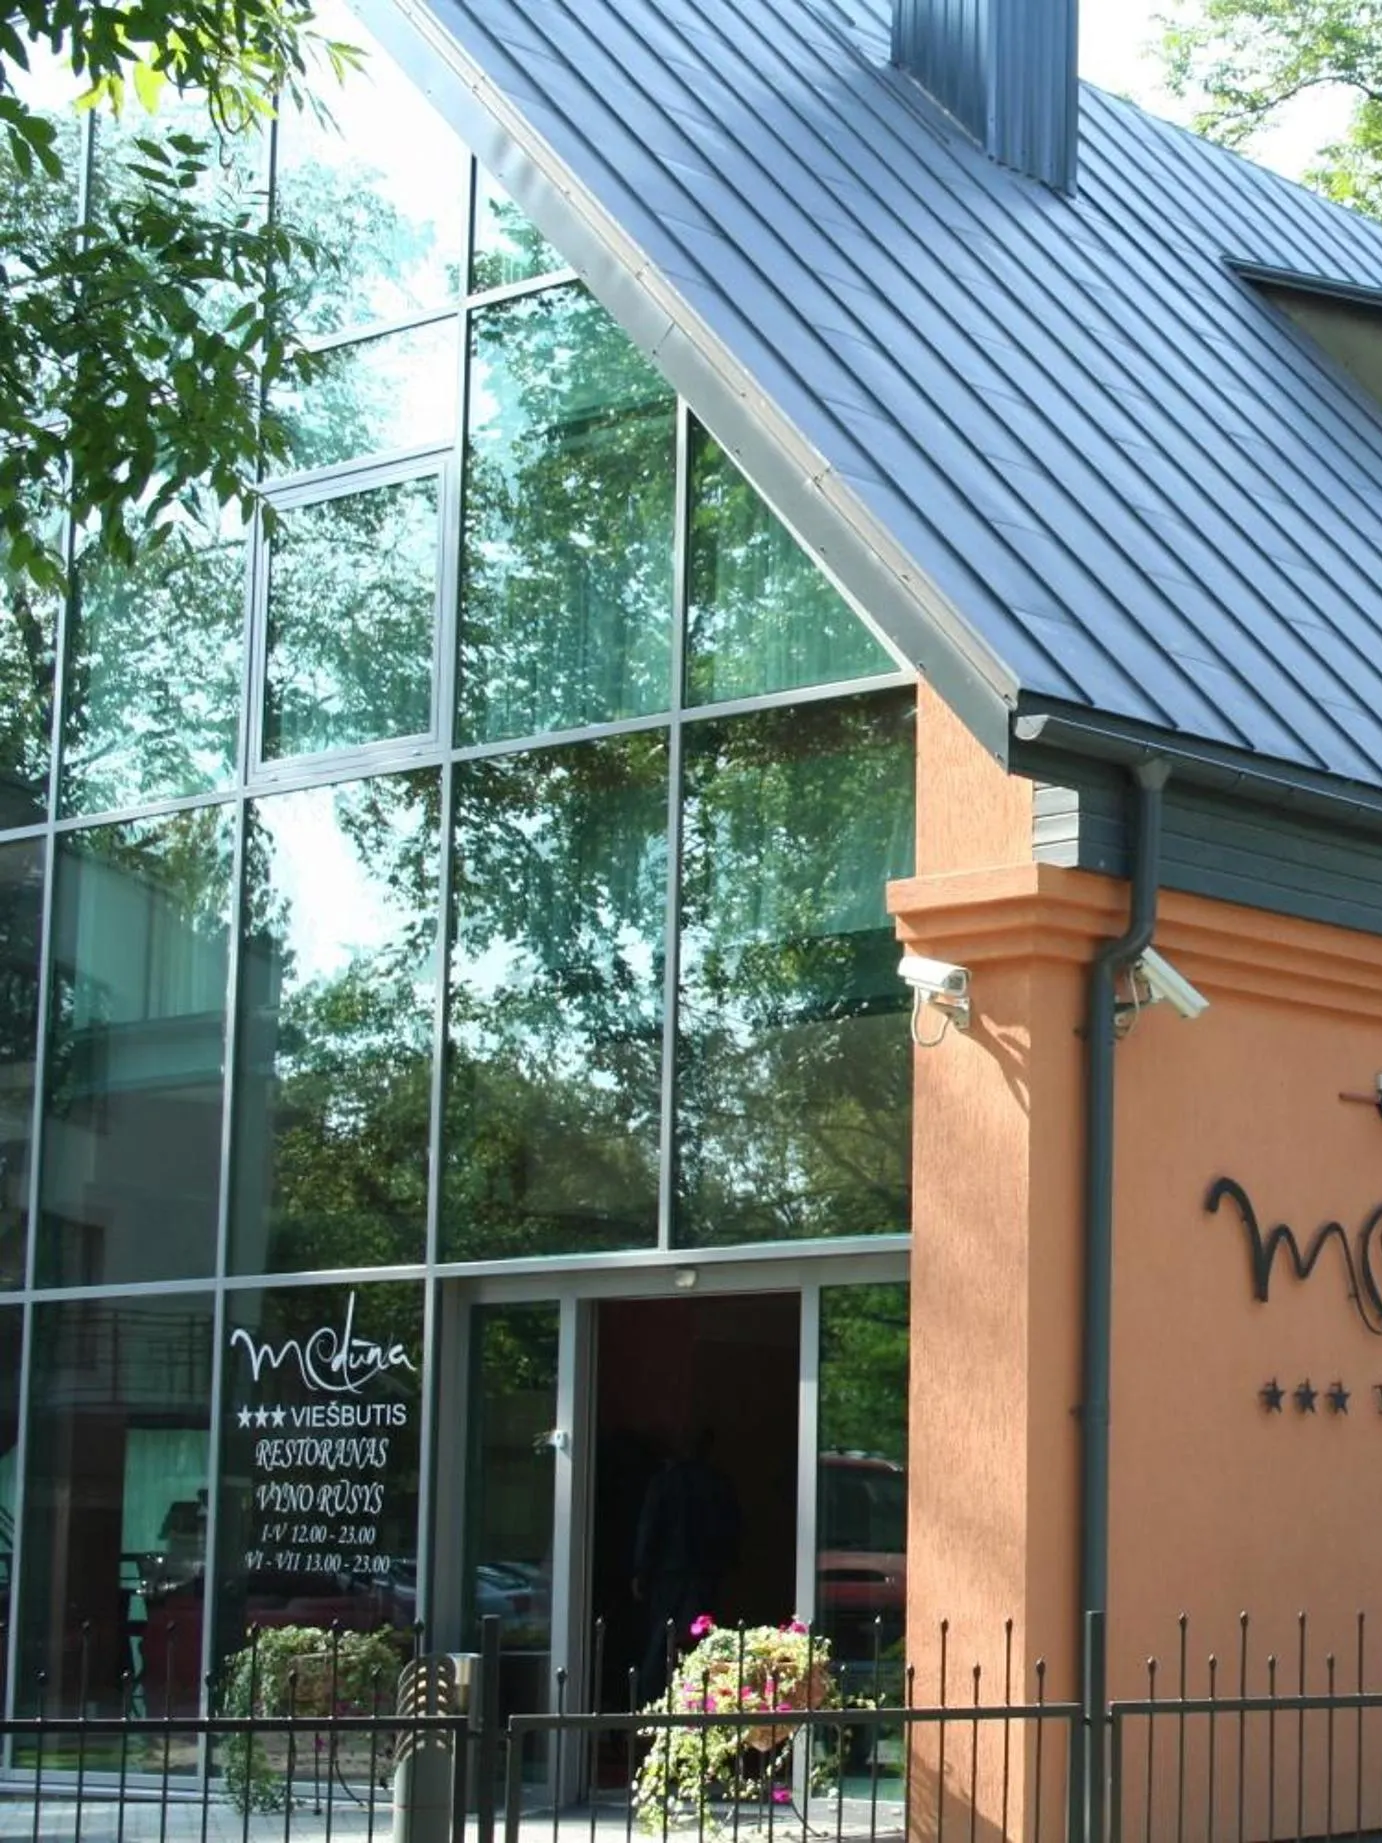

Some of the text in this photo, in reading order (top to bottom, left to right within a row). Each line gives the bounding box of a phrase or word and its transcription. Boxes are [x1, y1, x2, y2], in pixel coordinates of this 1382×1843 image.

[290, 1400, 408, 1428] VIEŠBUTIS
[255, 1436, 390, 1472] RESTORANAS
[256, 1478, 385, 1517] VYNO RŪSYS
[291, 1524, 328, 1544] 12.00
[337, 1525, 377, 1545] 23.00
[304, 1553, 343, 1572] 13.00
[352, 1554, 391, 1574] 23.00
